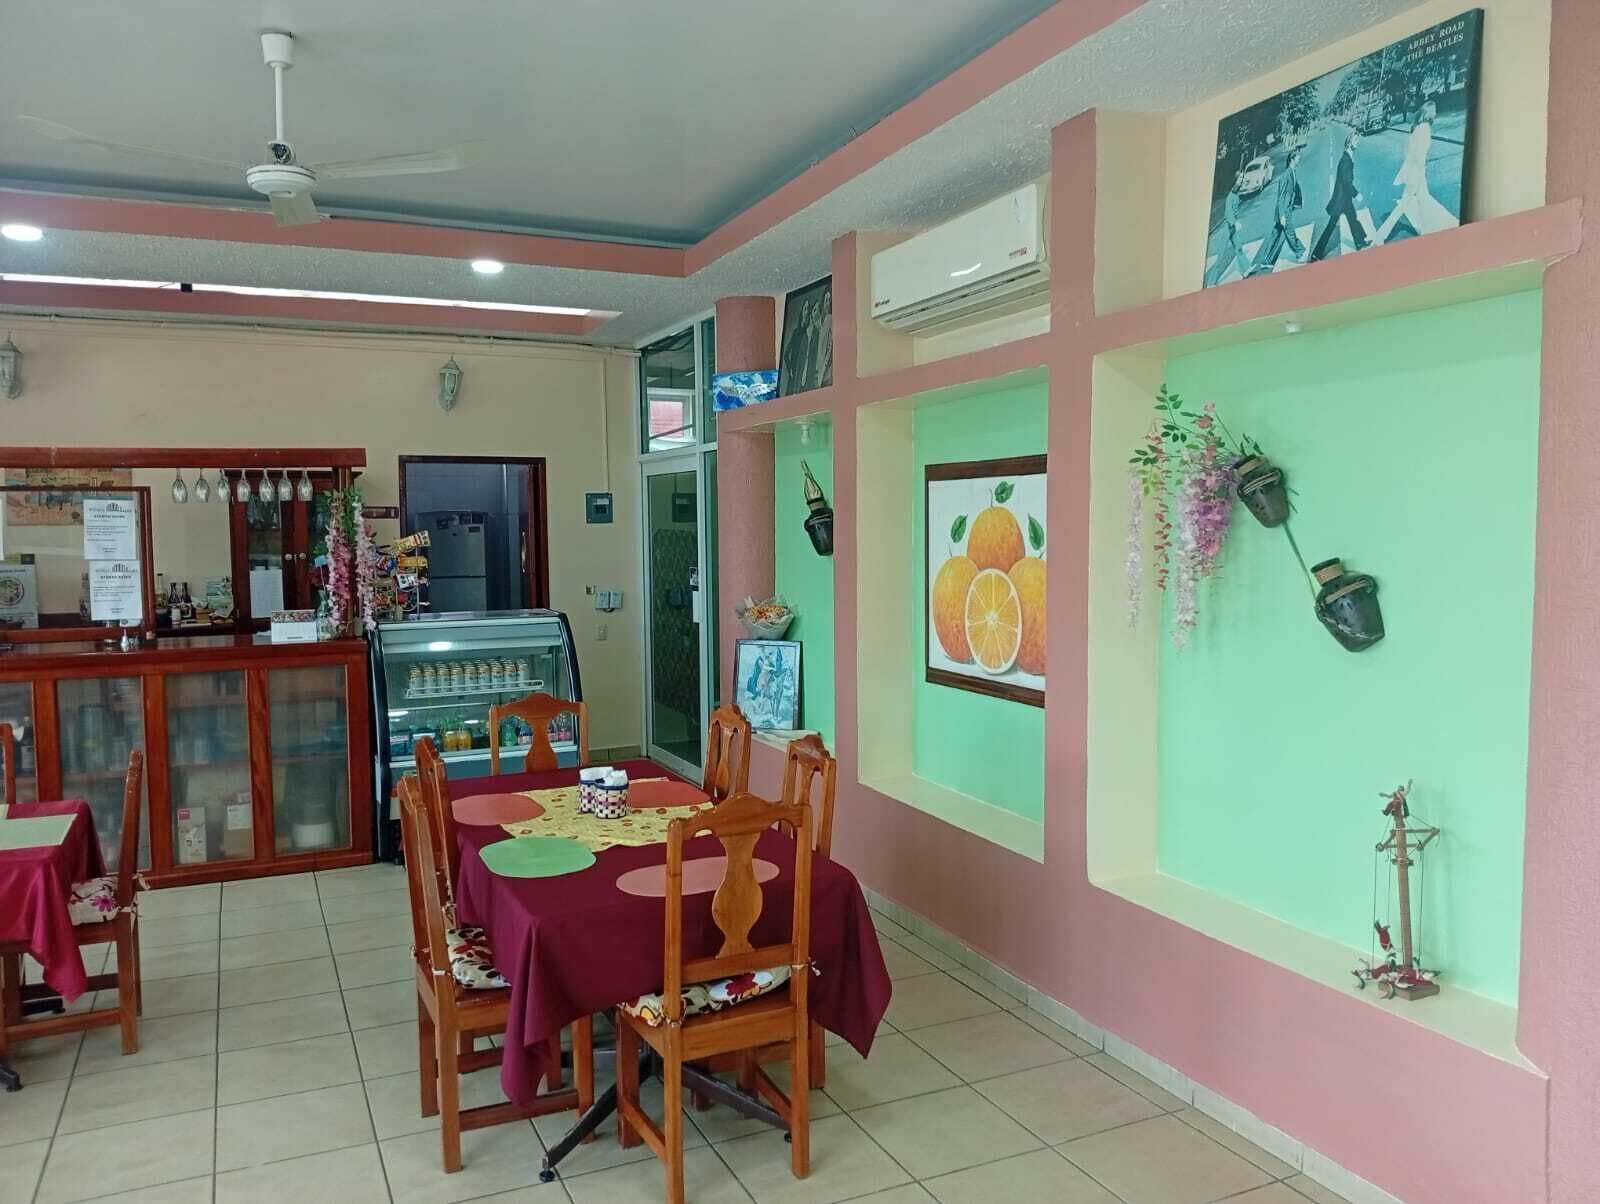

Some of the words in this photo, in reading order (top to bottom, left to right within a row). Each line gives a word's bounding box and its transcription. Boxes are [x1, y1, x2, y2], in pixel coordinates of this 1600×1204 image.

[1407, 49, 1424, 62] THE
[1425, 33, 1464, 55] BEATLES
[1408, 33, 1435, 51] ABBEY
[1439, 21, 1465, 38] ROAD
